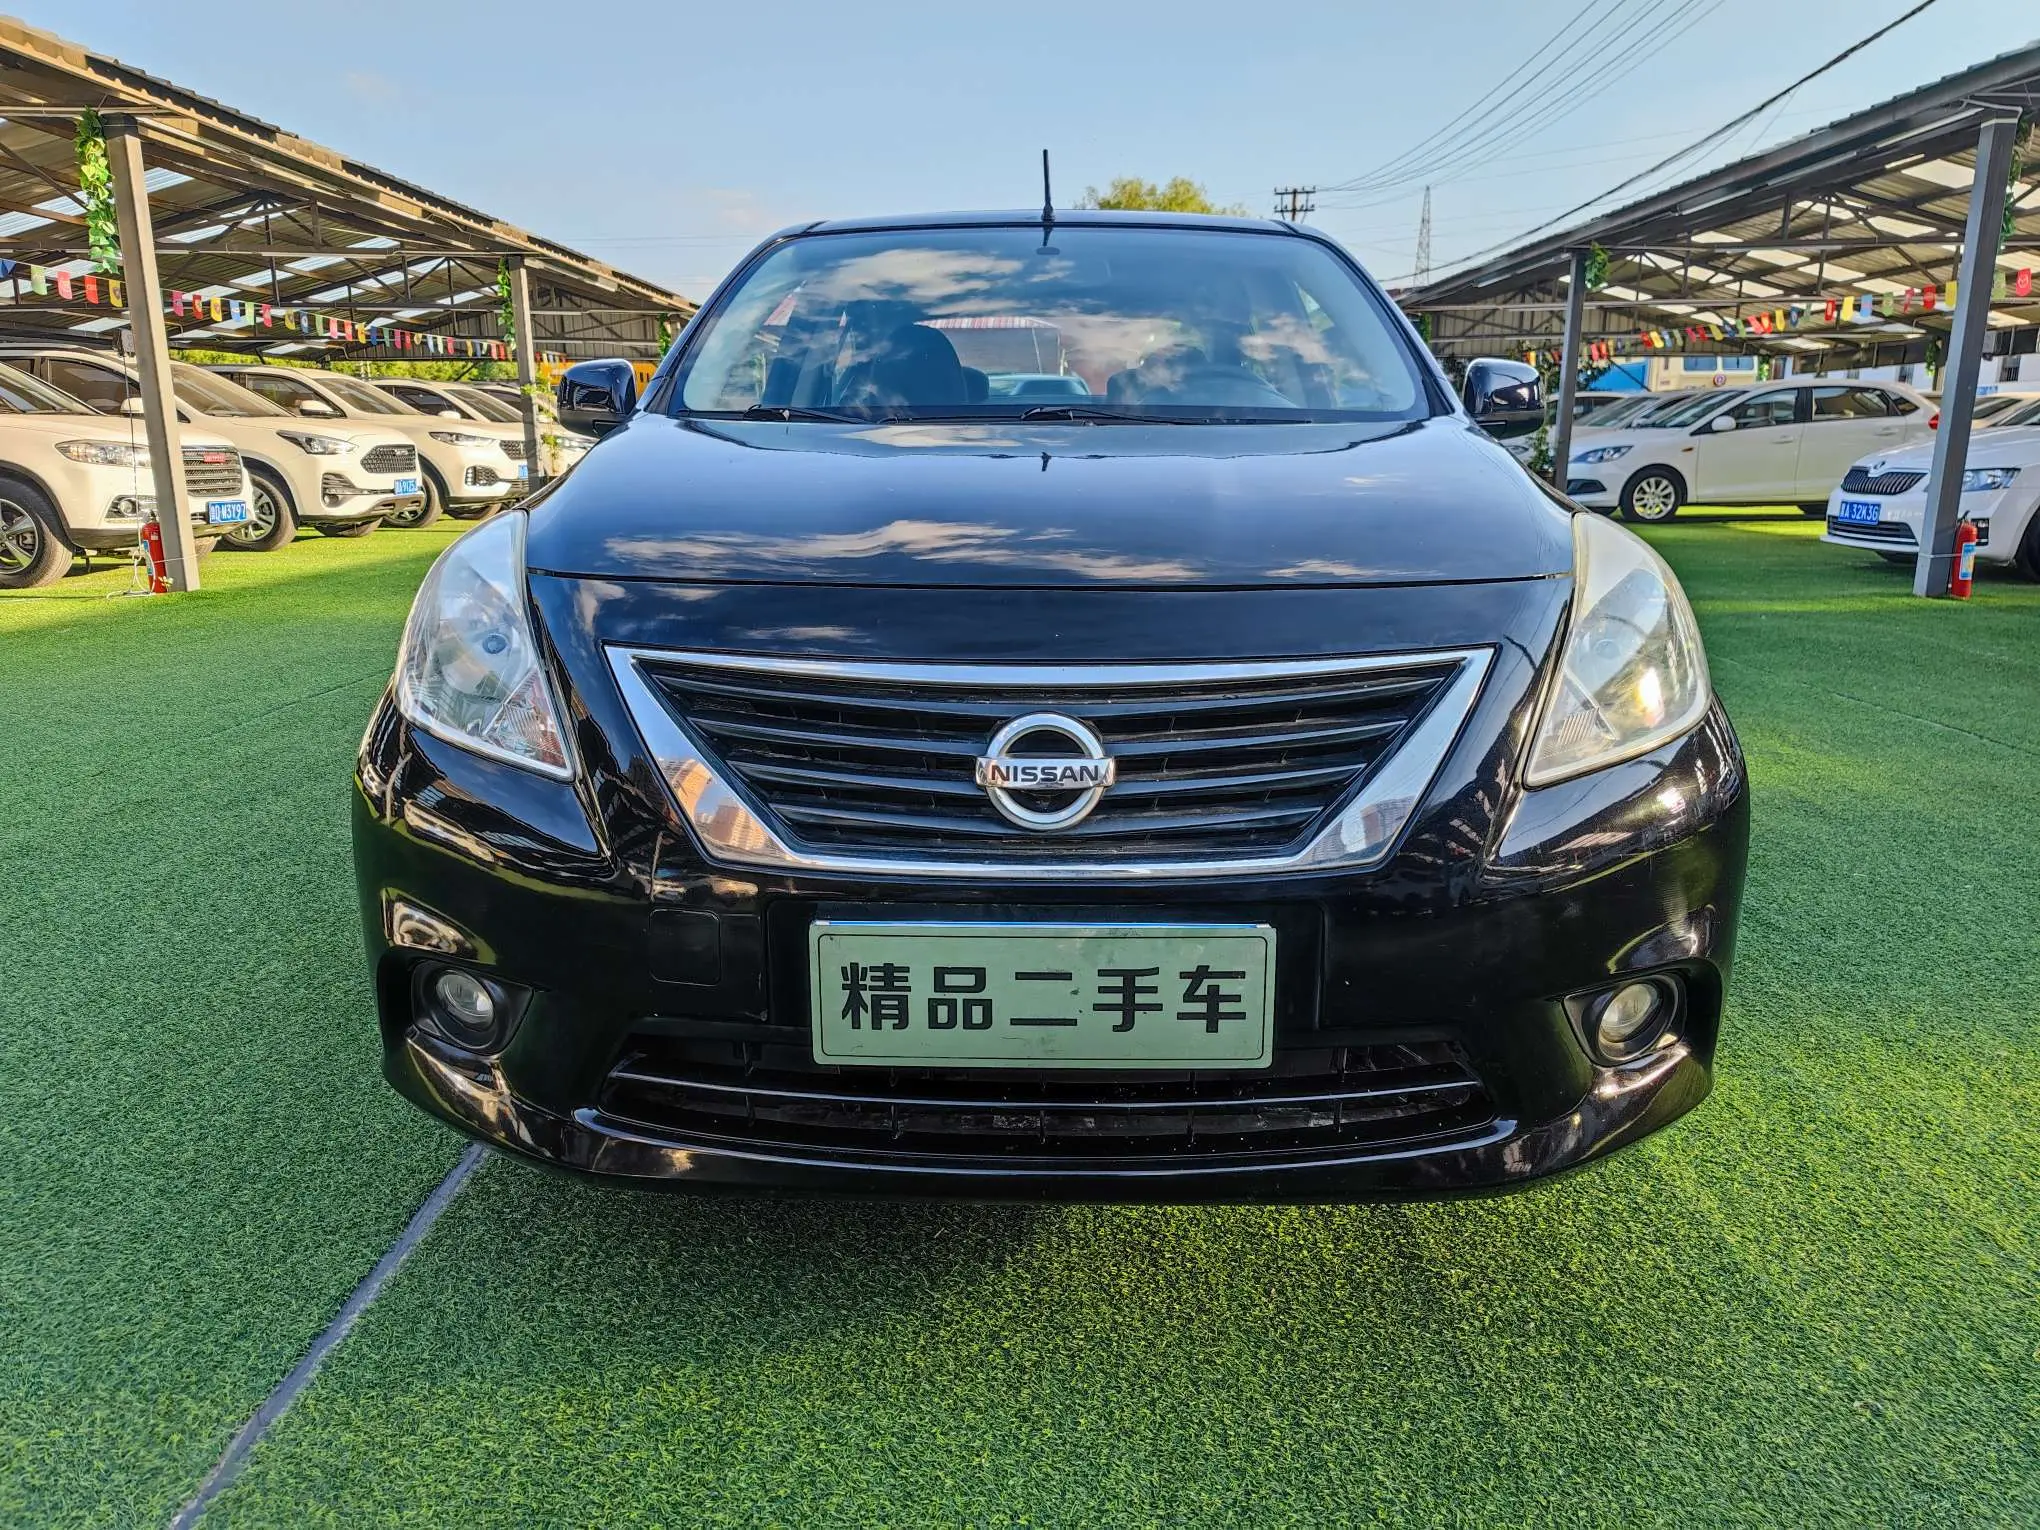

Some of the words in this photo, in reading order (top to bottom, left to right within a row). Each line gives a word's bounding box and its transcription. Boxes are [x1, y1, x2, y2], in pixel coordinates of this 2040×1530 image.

[990, 764, 1099, 783] NISSAN
[840, 961, 1247, 1034] 精品二手车
